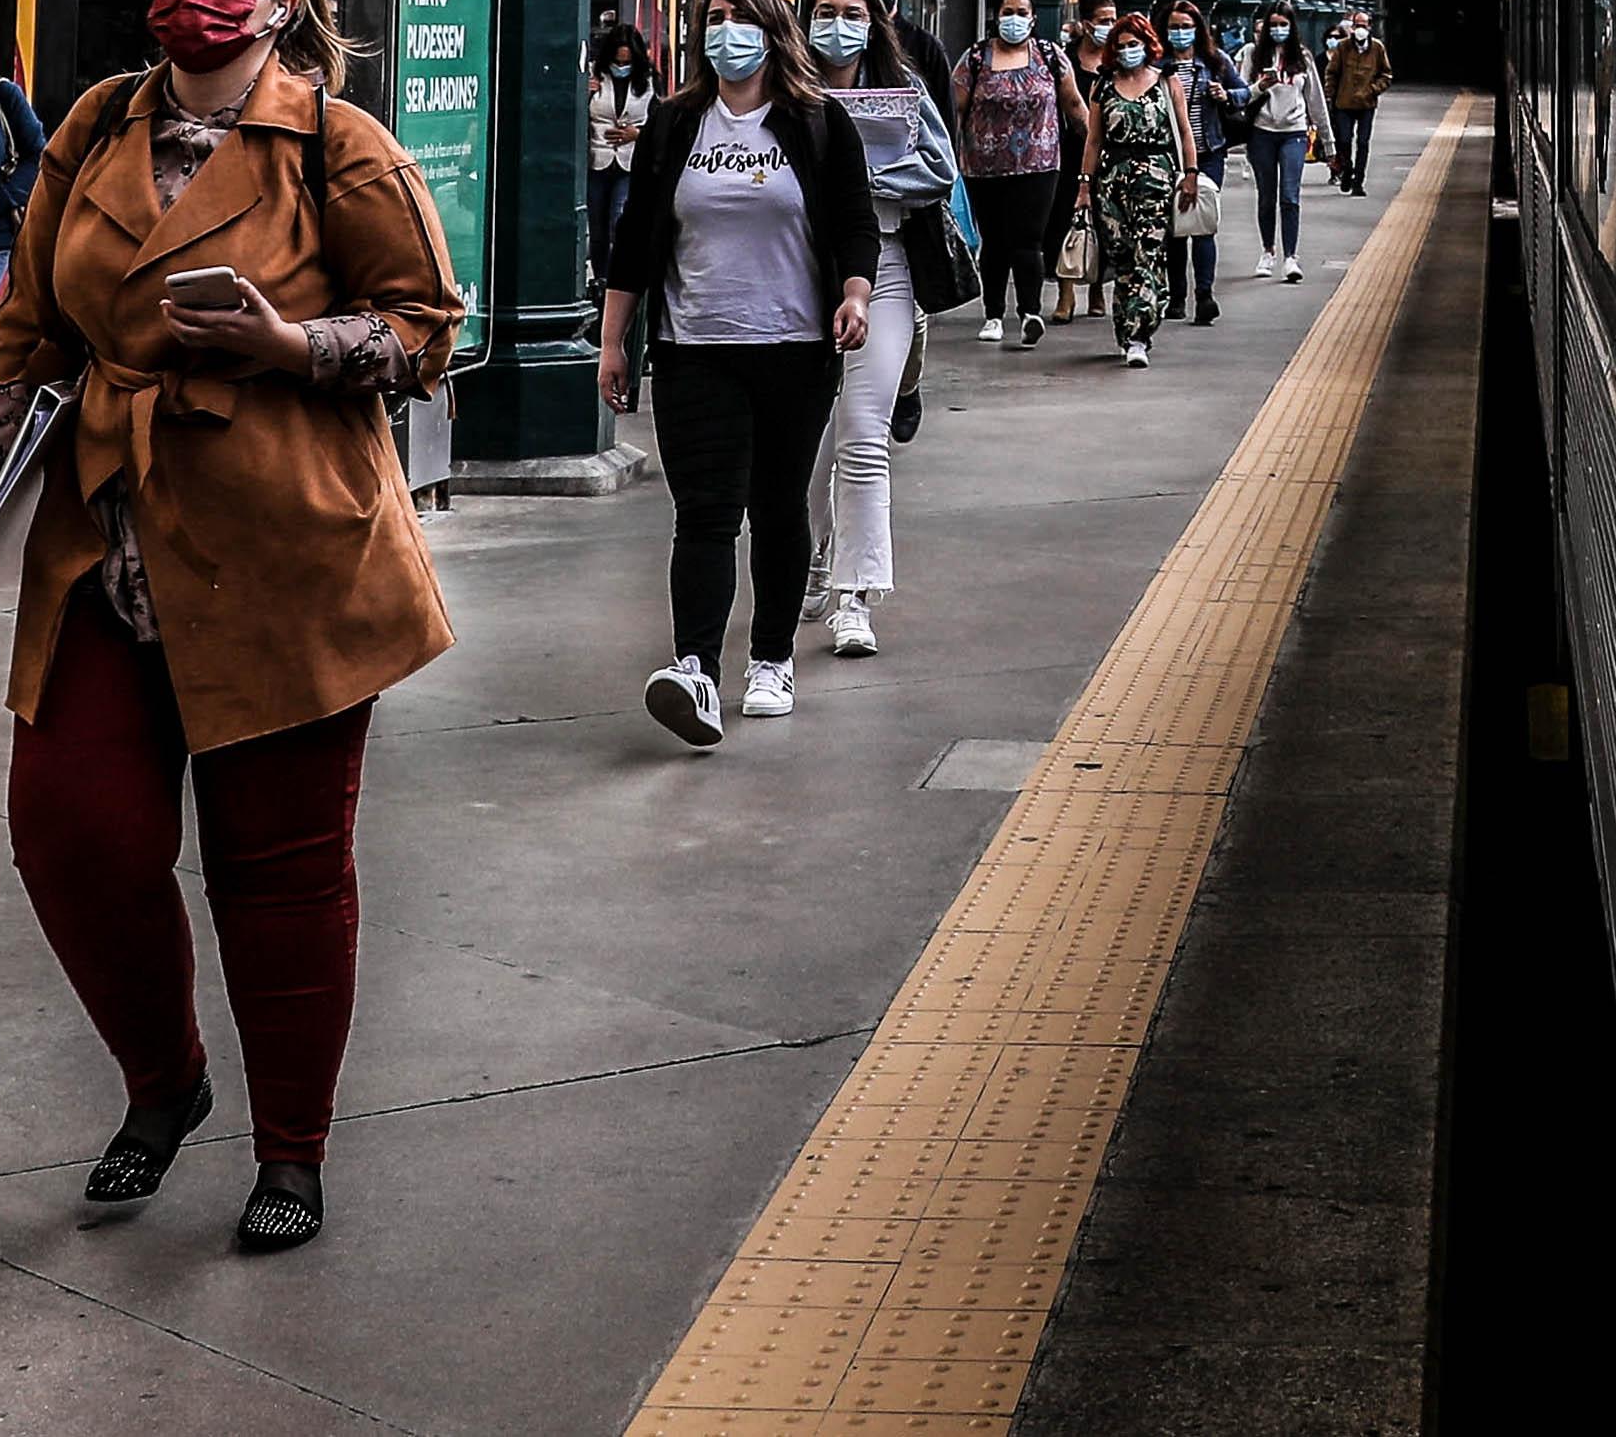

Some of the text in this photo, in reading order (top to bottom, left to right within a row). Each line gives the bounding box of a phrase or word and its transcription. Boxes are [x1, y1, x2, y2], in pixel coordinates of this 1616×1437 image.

[406, 24, 465, 59] PUDESSEM
[405, 75, 479, 113] SER JARDINS?
